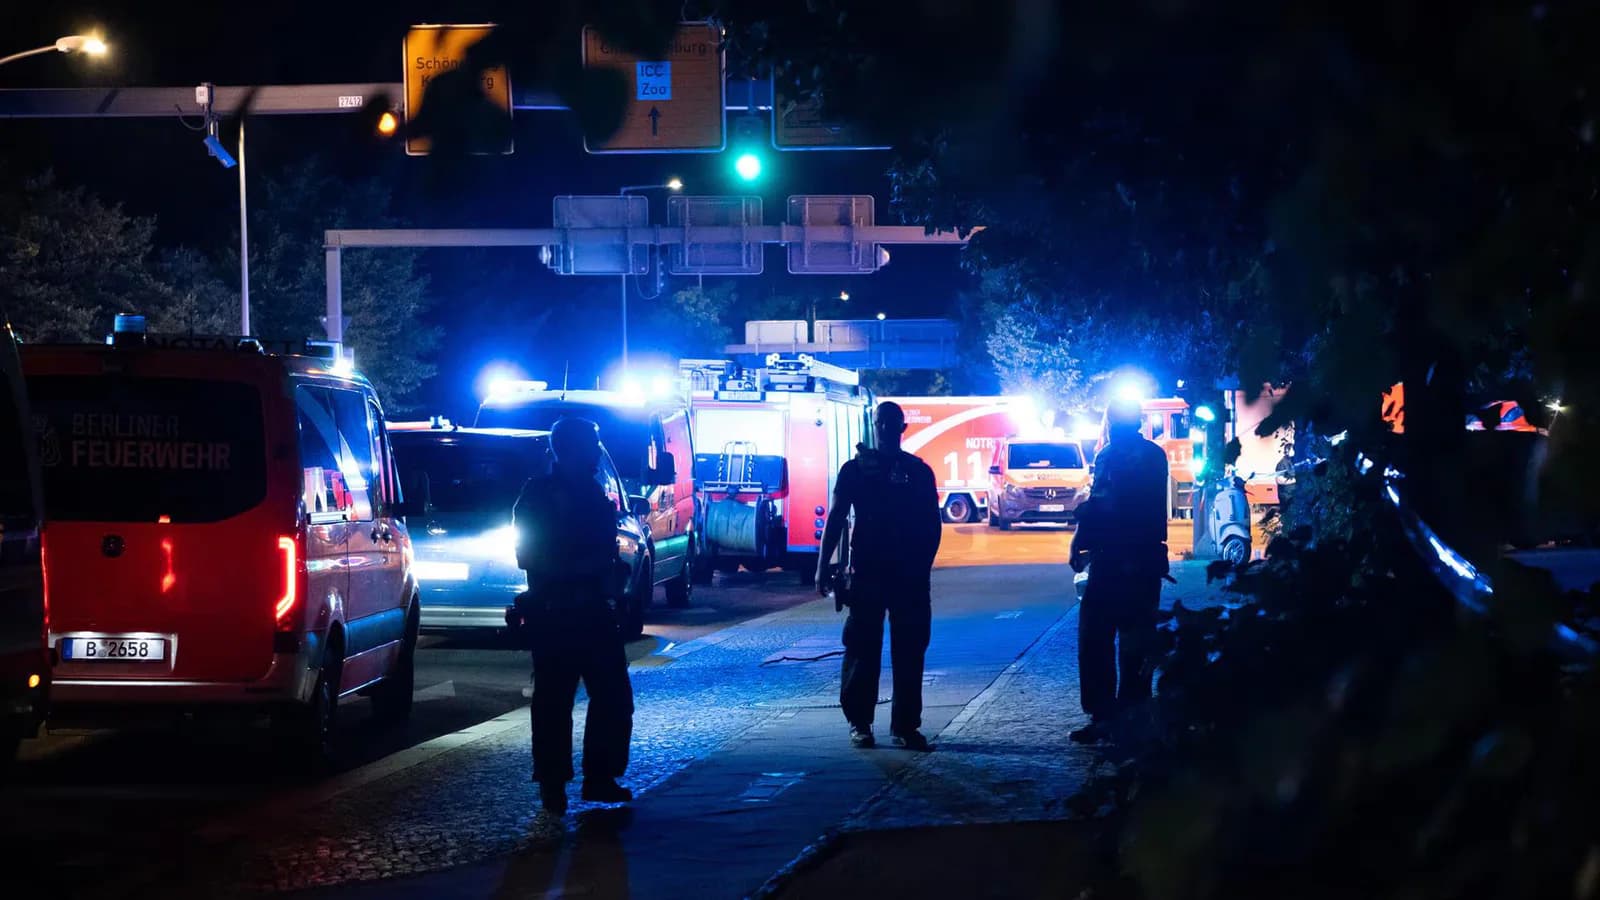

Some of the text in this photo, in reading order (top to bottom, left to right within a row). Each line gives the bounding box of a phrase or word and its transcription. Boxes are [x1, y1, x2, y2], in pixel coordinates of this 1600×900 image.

[640, 65, 664, 77] ICC
[641, 83, 667, 95] Zoo
[72, 413, 180, 437] BERLINER
[72, 441, 231, 470] FEUERWEHR
[86, 641, 149, 657] B 2658
